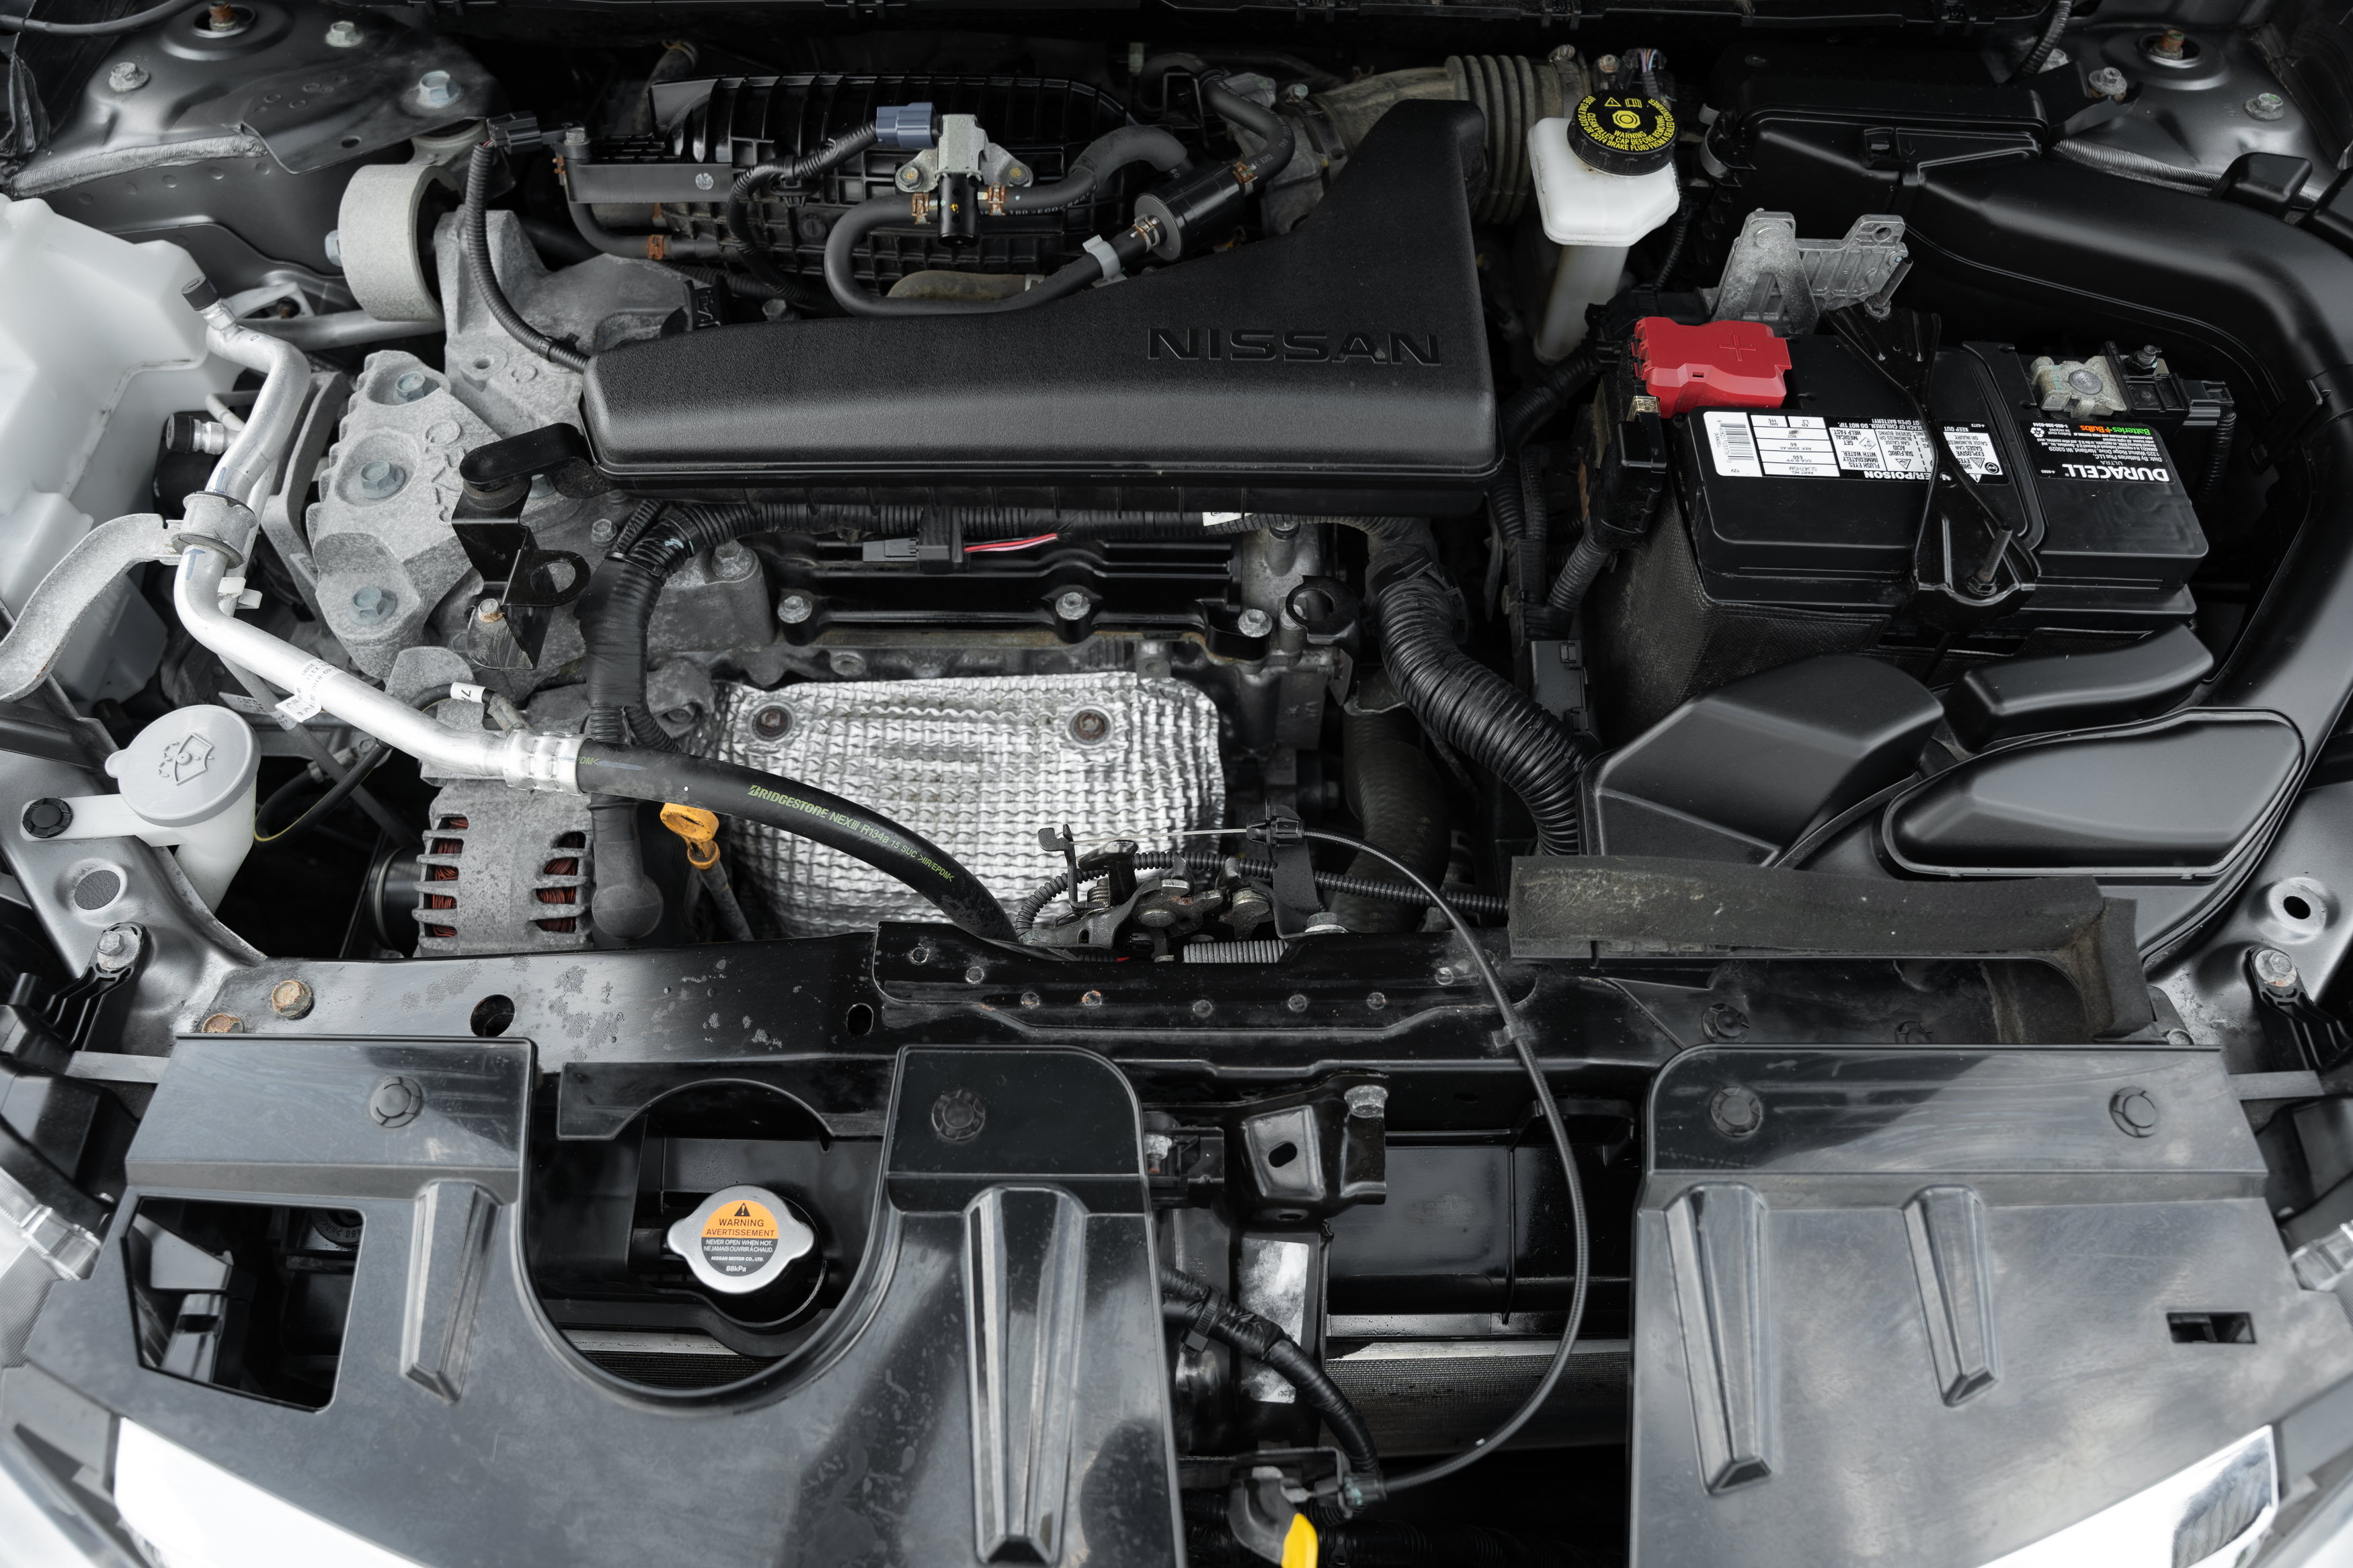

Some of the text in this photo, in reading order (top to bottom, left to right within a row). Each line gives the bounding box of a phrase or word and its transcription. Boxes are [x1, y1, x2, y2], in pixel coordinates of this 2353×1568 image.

[1583, 95, 1596, 105] USE
[1648, 98, 1674, 121] CONTAINER
[1587, 113, 1599, 128] CLEAN
[1594, 127, 1615, 141] FILLER
[1630, 135, 1657, 145] BEFORE
[1652, 115, 1665, 138] REMOVING
[1614, 130, 1646, 139] WARNING
[1663, 122, 1675, 138] SEALED
[1591, 132, 1607, 144] DOT4
[1648, 138, 1666, 149] FROM
[1607, 140, 1629, 151] BRAKE
[1148, 328, 1441, 366] NISSAN
[2062, 464, 2169, 482] DURACELL
[747, 784, 830, 819] BRIDGESTONE
[861, 824, 890, 844] R134a
[891, 839, 901, 850] 15
[901, 845, 918, 858] SUC
[719, 1219, 764, 1227] WARNING
[706, 1229, 775, 1237] AVERTISSEMENT
